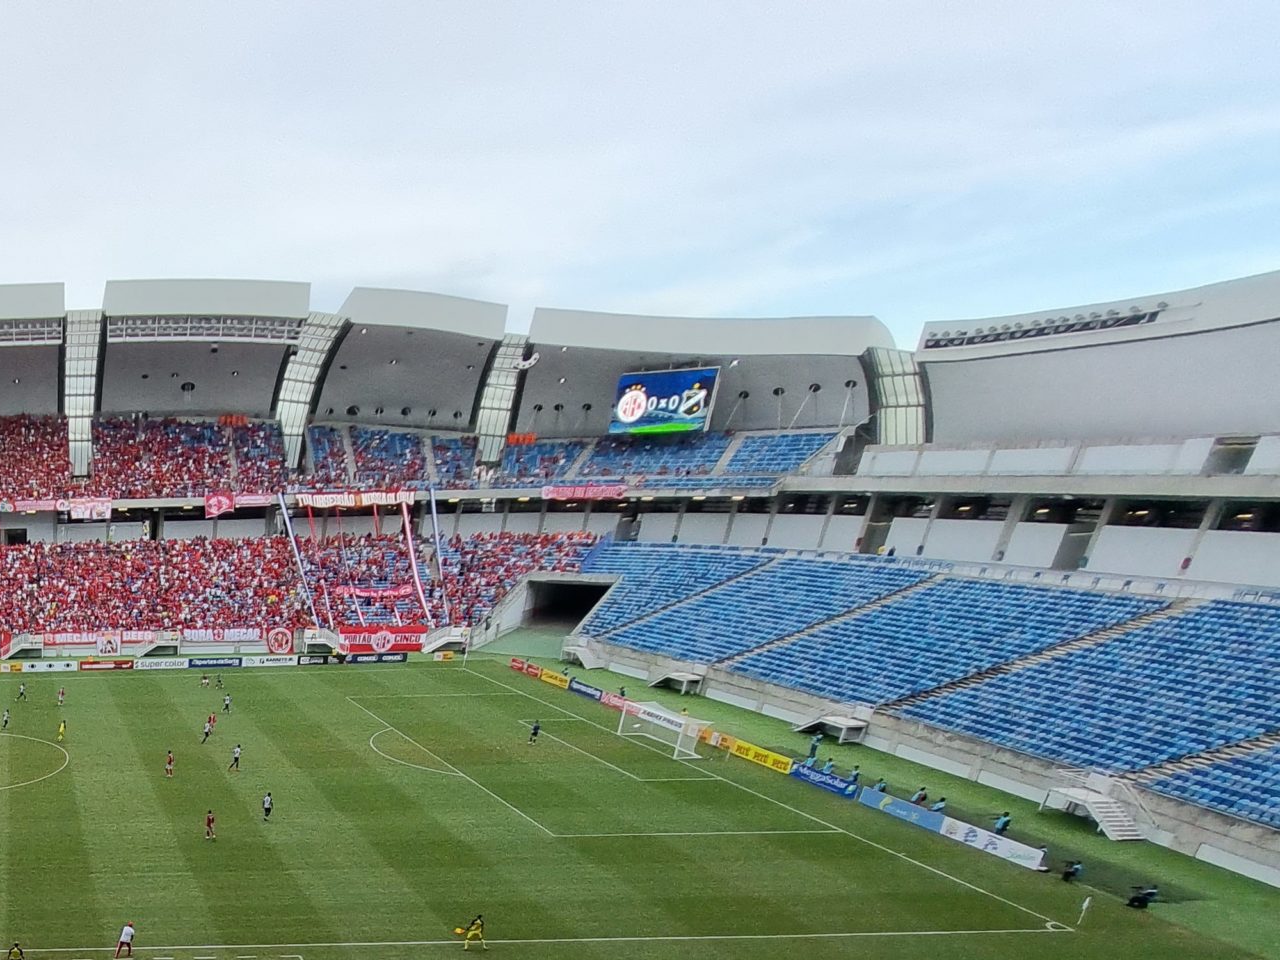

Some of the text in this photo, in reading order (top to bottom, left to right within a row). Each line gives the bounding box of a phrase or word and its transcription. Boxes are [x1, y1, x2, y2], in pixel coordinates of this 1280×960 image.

[344, 632, 421, 643] PORTÃO CINCO
[141, 661, 164, 669] super
[798, 767, 848, 788] MeggaSolar
